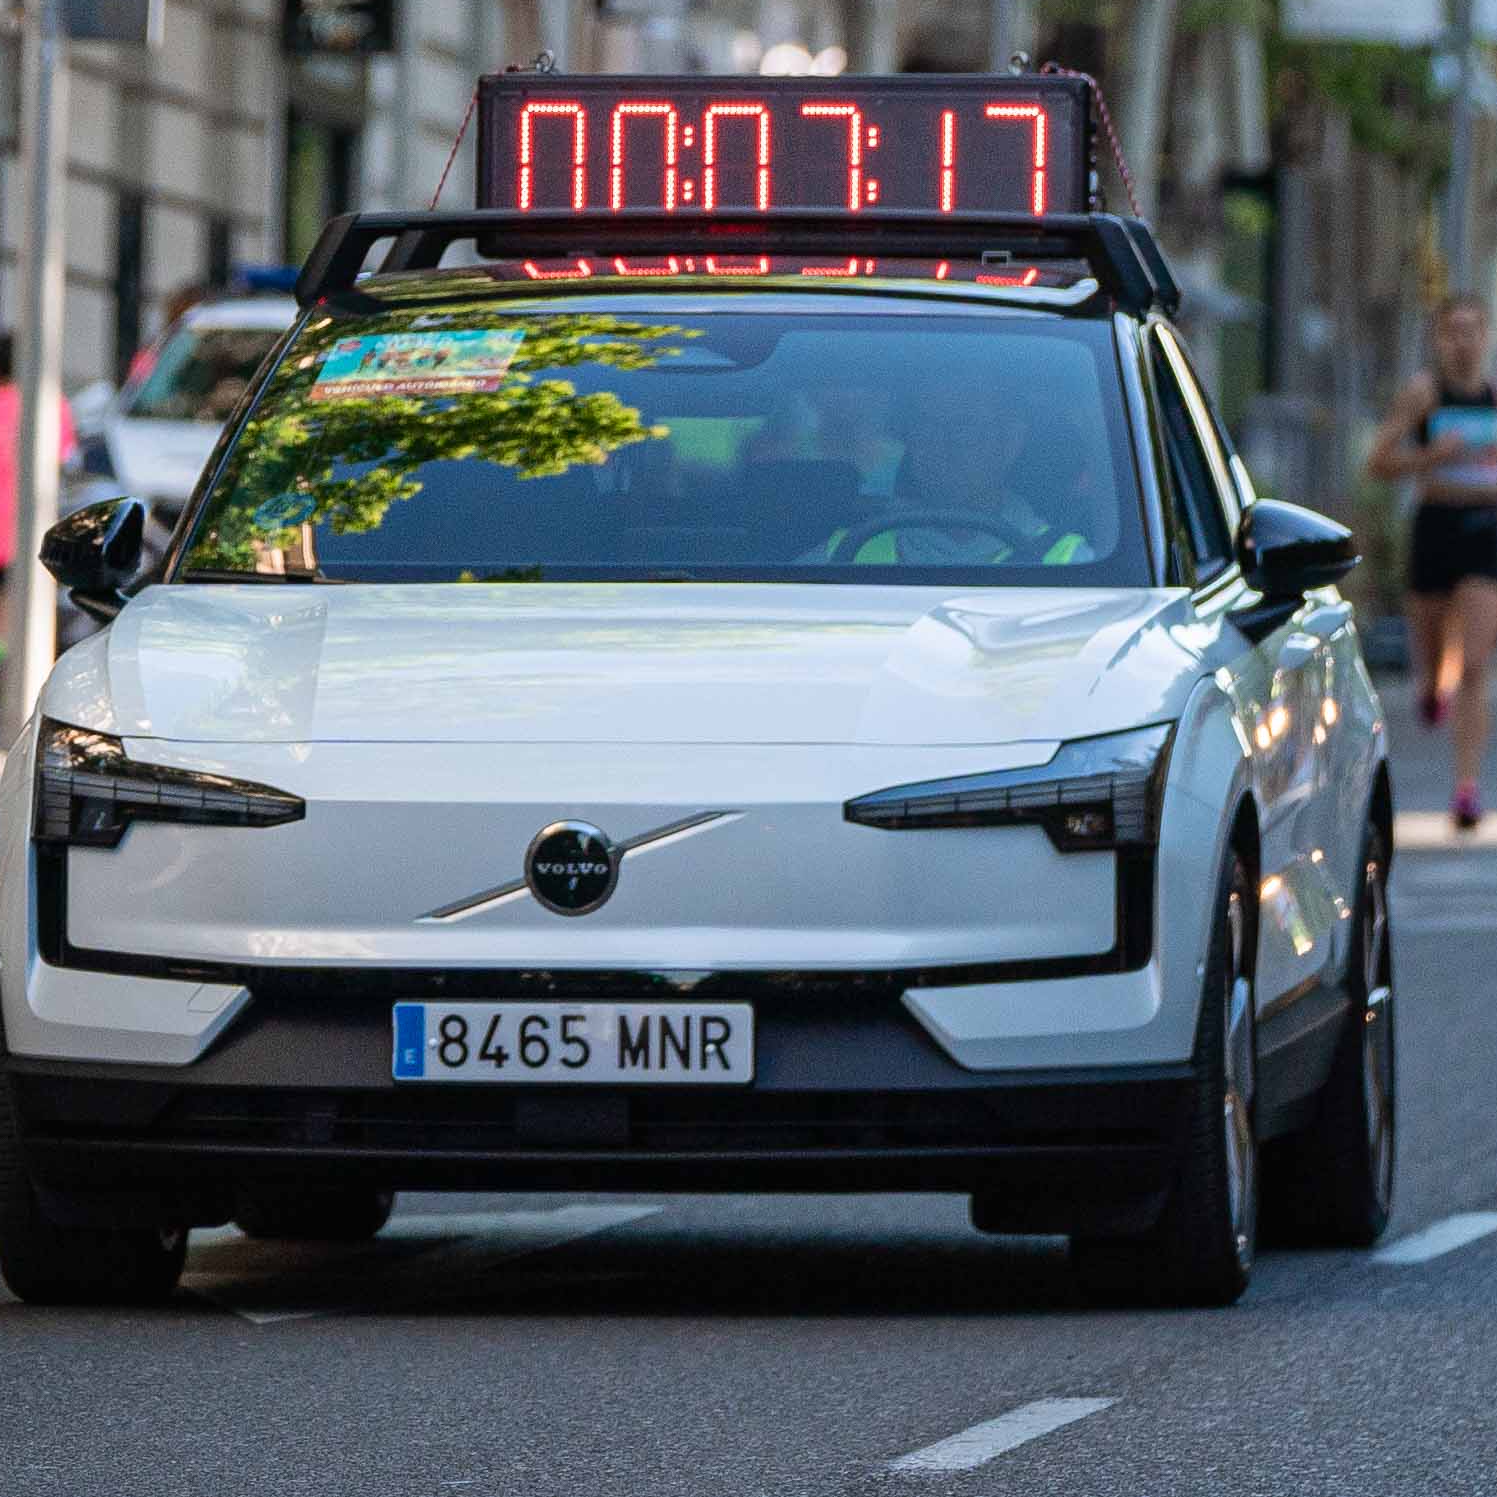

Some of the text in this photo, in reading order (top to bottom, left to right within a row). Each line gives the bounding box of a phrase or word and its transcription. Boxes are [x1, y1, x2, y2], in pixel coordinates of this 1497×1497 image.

[519, 101, 1046, 214] 00:07:17
[536, 862, 609, 875] VOLVO
[438, 1013, 731, 1070] 8465 MNR
